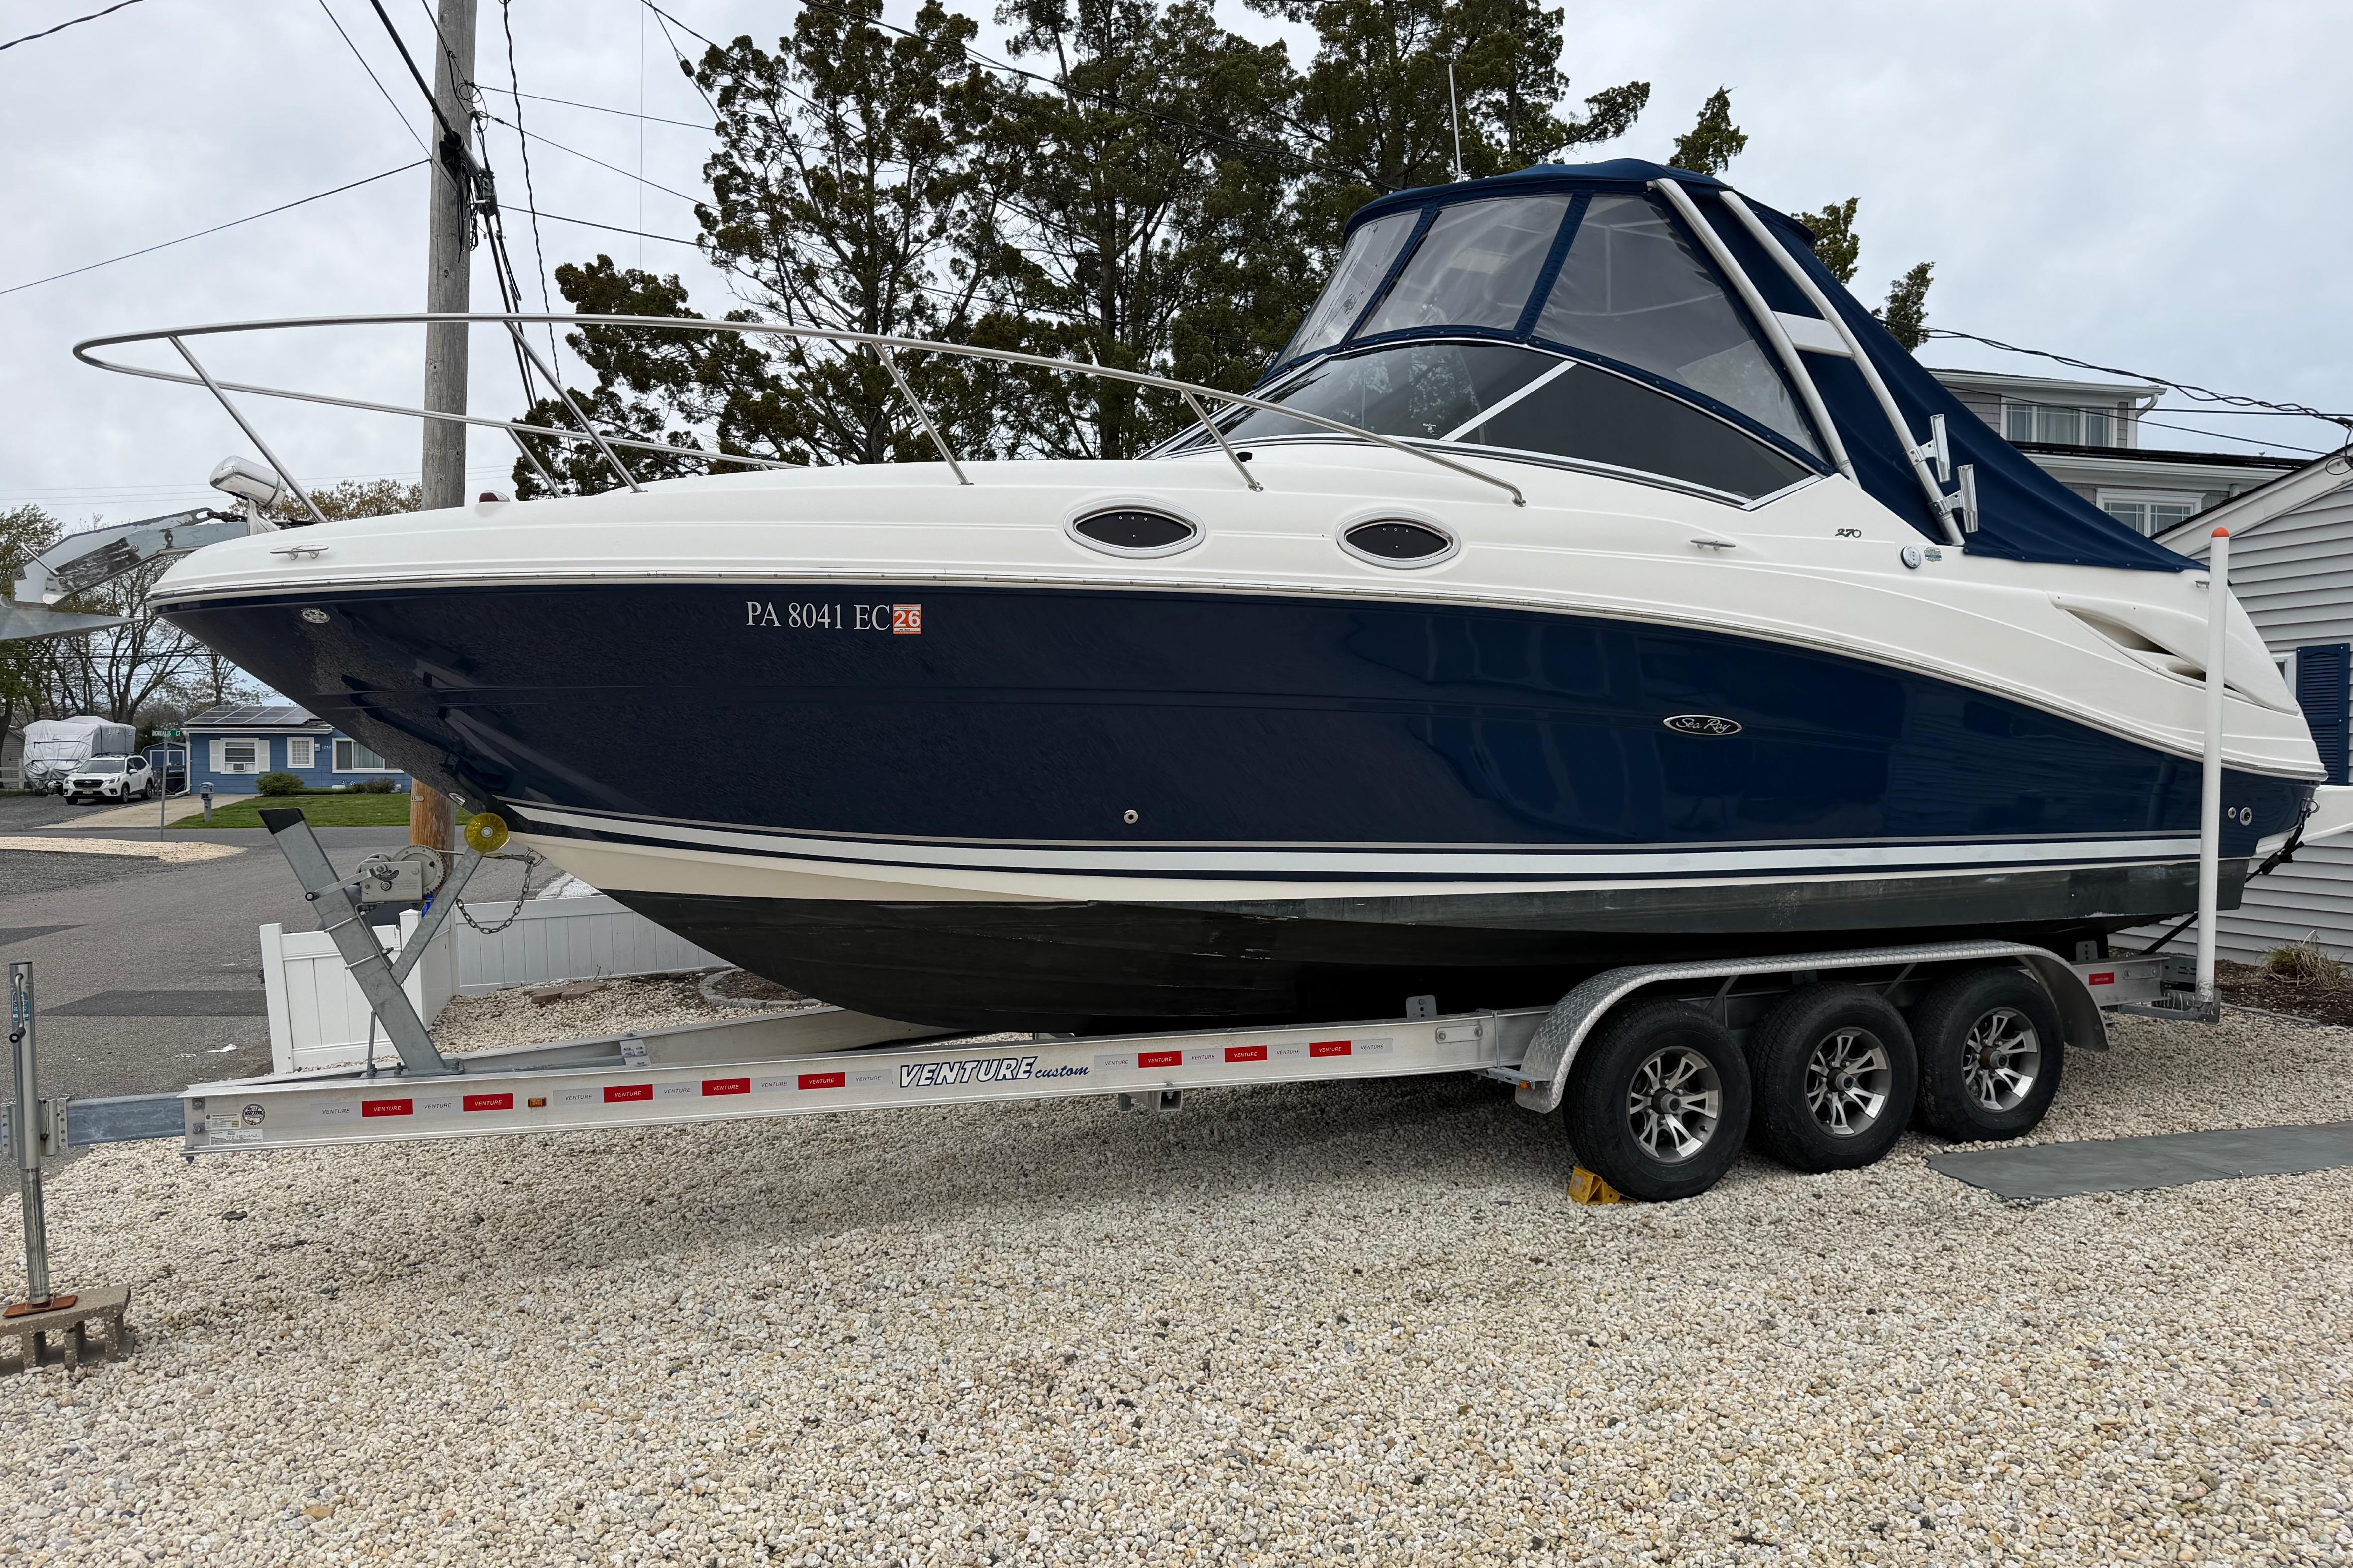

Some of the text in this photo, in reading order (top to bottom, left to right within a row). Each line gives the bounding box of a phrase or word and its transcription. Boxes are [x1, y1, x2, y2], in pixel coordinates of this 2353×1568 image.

[1835, 528, 1862, 538] 270
[745, 601, 890, 631] PA 8041 EC
[894, 611, 921, 627] 26
[1676, 718, 1731, 733] Sea Ray
[900, 1056, 1090, 1088] VENTURE custom
